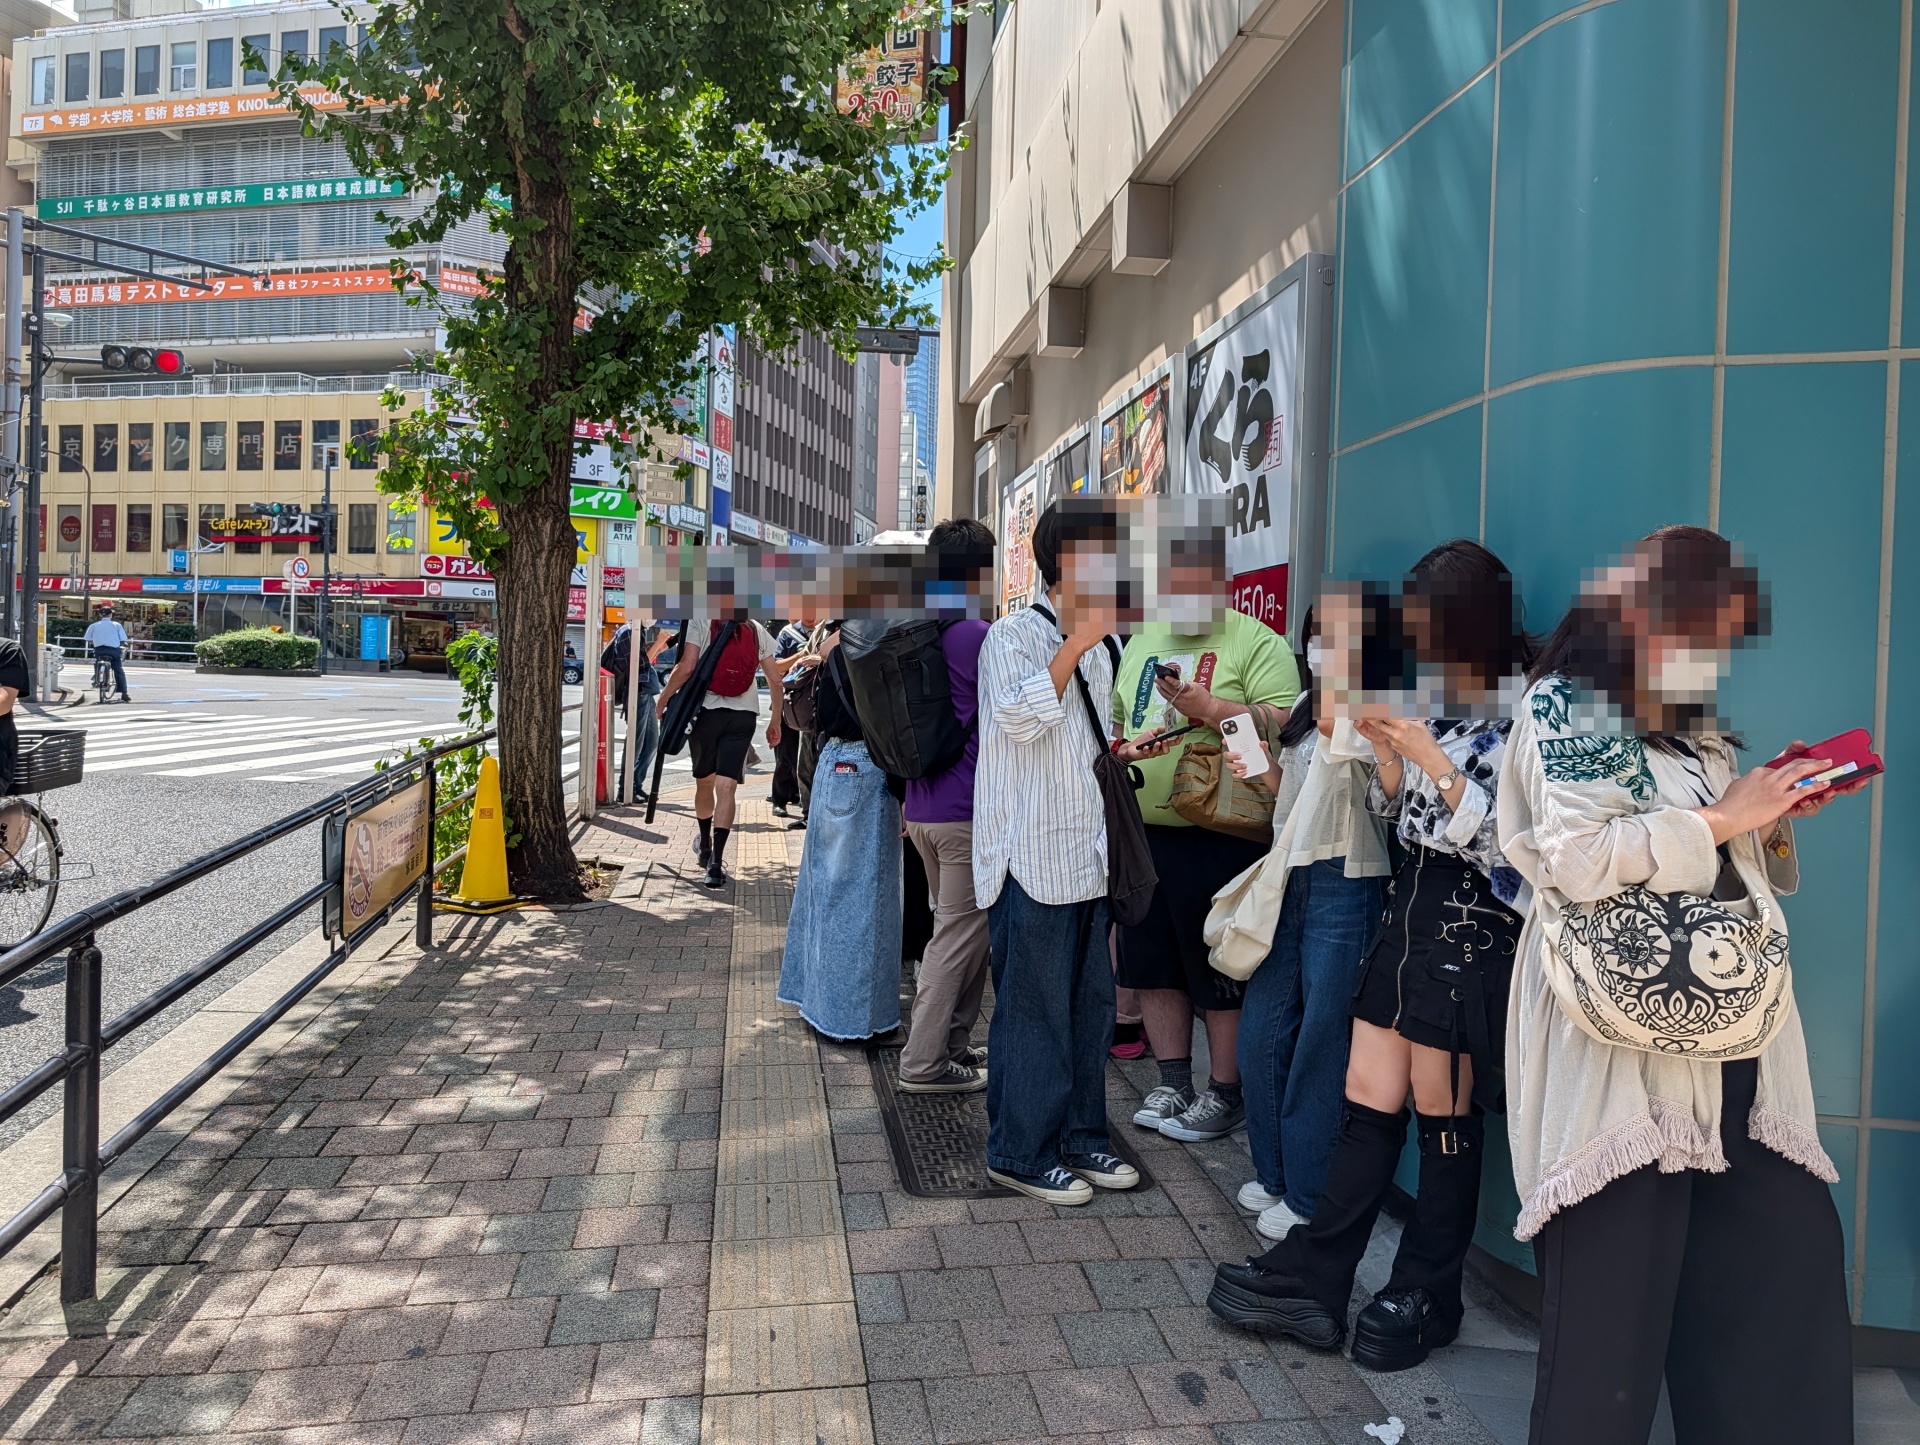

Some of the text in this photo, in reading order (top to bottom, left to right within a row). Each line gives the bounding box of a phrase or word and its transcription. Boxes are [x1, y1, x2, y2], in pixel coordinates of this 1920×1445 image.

[877, 63, 917, 86] 餃子
[29, 119, 40, 128] 7F
[172, 100, 230, 118] 総合進学塾
[57, 202, 73, 214] SJI
[263, 180, 392, 201] 日本語教師養成講座
[1190, 357, 1207, 390] 4F
[1199, 348, 1274, 483] くら
[589, 464, 604, 476] 3F
[613, 522, 633, 534] 銀行
[613, 533, 632, 541] ATM
[432, 602, 470, 611] 名店ビル
[1201, 656, 1212, 674] LOS
[1135, 661, 1155, 723] SANTA MONICA
